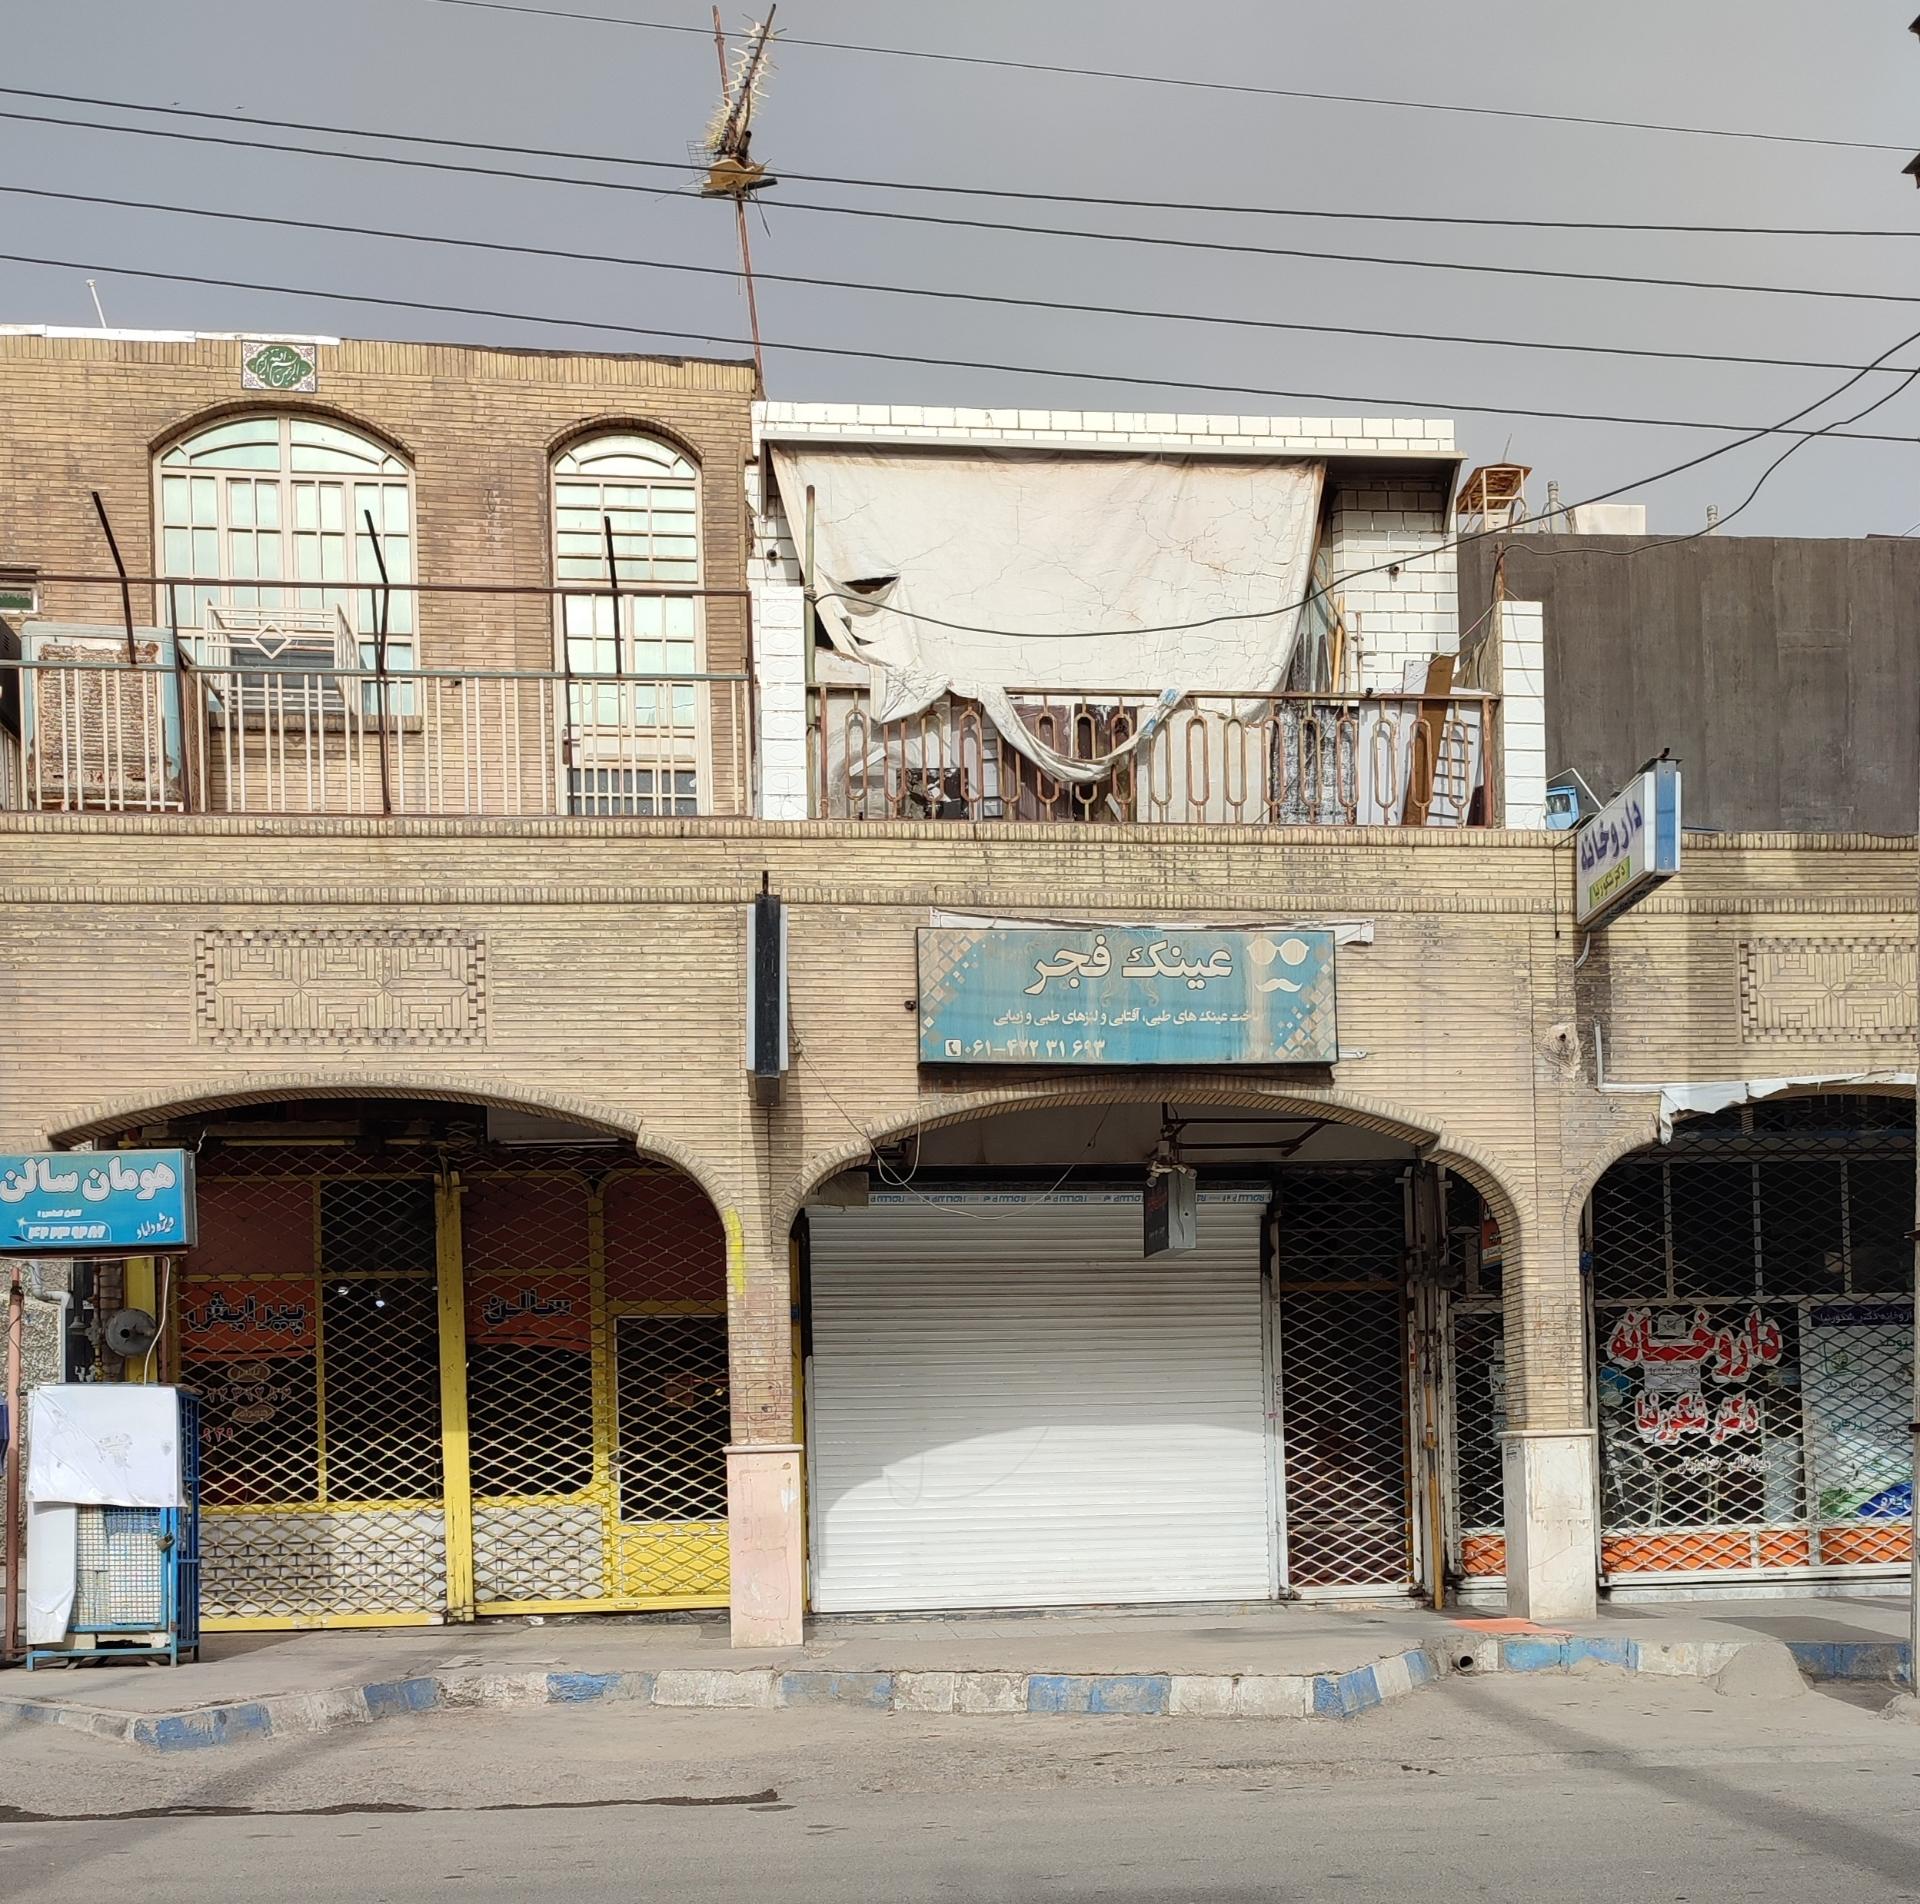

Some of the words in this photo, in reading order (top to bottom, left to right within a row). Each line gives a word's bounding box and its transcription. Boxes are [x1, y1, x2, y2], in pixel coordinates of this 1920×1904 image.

[1580, 798, 1643, 872] داروخانه
[1615, 864, 1625, 888] دکتر
[1023, 933, 1113, 994] فجر
[1122, 939, 1234, 991] عینک
[1033, 1009, 1060, 1026] طبی
[1109, 1007, 1141, 1026] آفتابی
[1173, 1010, 1197, 1025] های
[0, 1156, 79, 1203] سالن
[82, 1155, 176, 1202] هومان
[188, 1291, 306, 1336] پیرایش
[482, 1288, 572, 1326] سالن
[1607, 1306, 1783, 1384] داروخانه
[1710, 1391, 1759, 1445] دکتر
